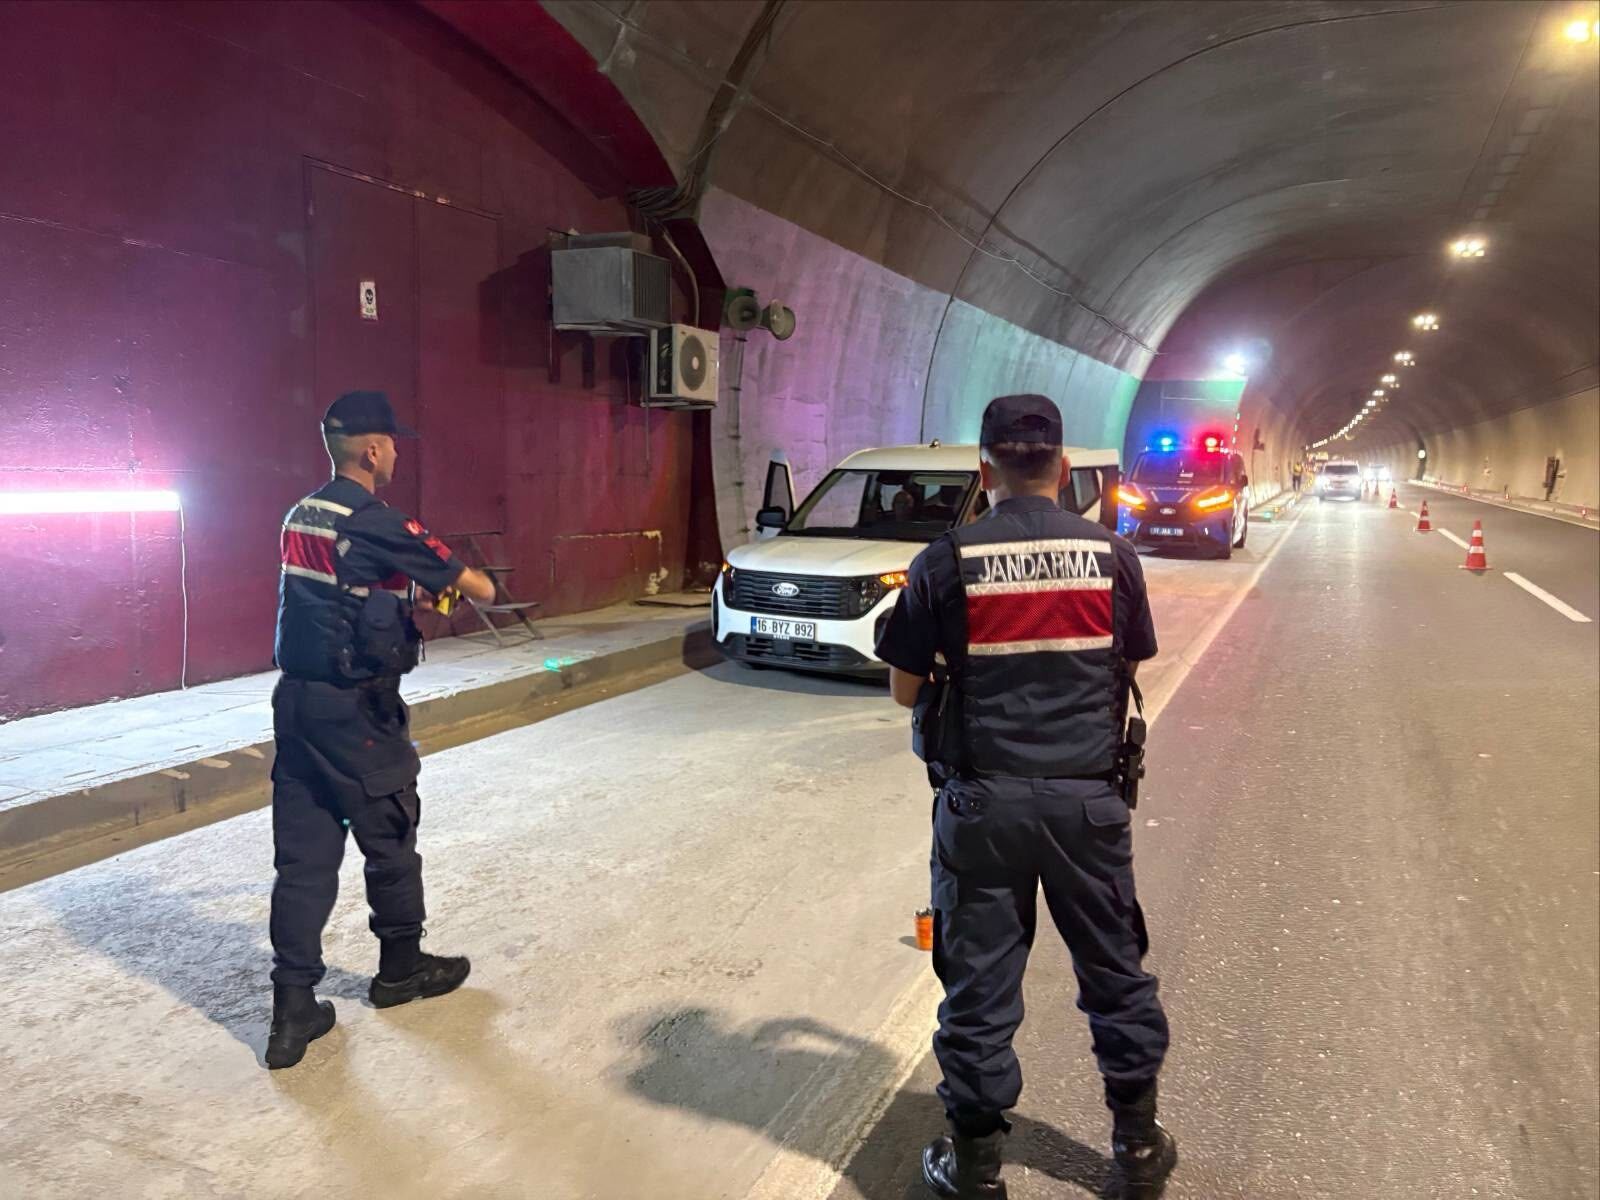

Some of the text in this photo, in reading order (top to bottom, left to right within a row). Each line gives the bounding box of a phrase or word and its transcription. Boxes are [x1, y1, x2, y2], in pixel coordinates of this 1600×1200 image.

[978, 551, 1101, 583] JANDARMA
[758, 620, 813, 638] 16 BYZ 892
